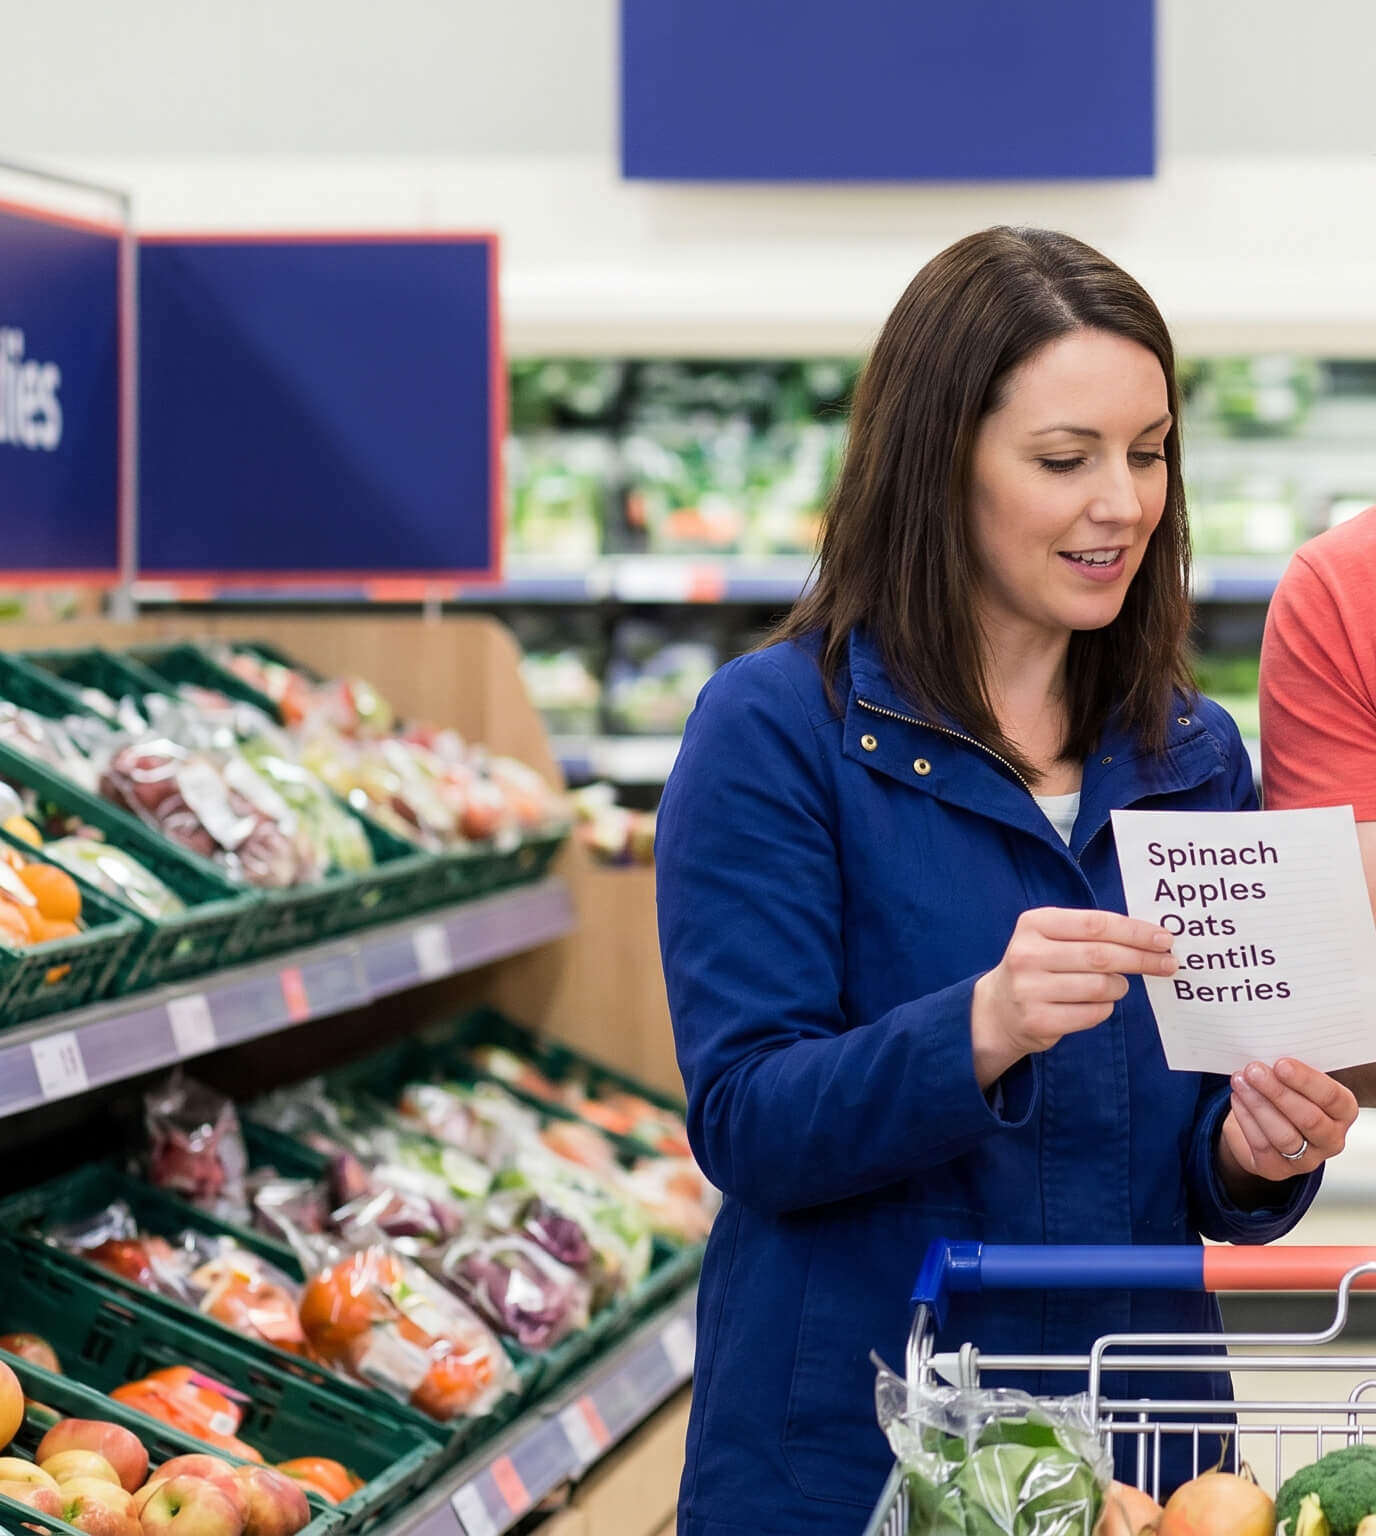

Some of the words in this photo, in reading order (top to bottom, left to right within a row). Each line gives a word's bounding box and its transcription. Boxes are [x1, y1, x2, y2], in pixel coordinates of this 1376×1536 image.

[1147, 840, 1279, 873] Spinach
[1154, 877, 1267, 908] Apples
[1160, 914, 1236, 937] Oats
[1168, 945, 1276, 970] entils
[1173, 978, 1291, 1002] Berries
